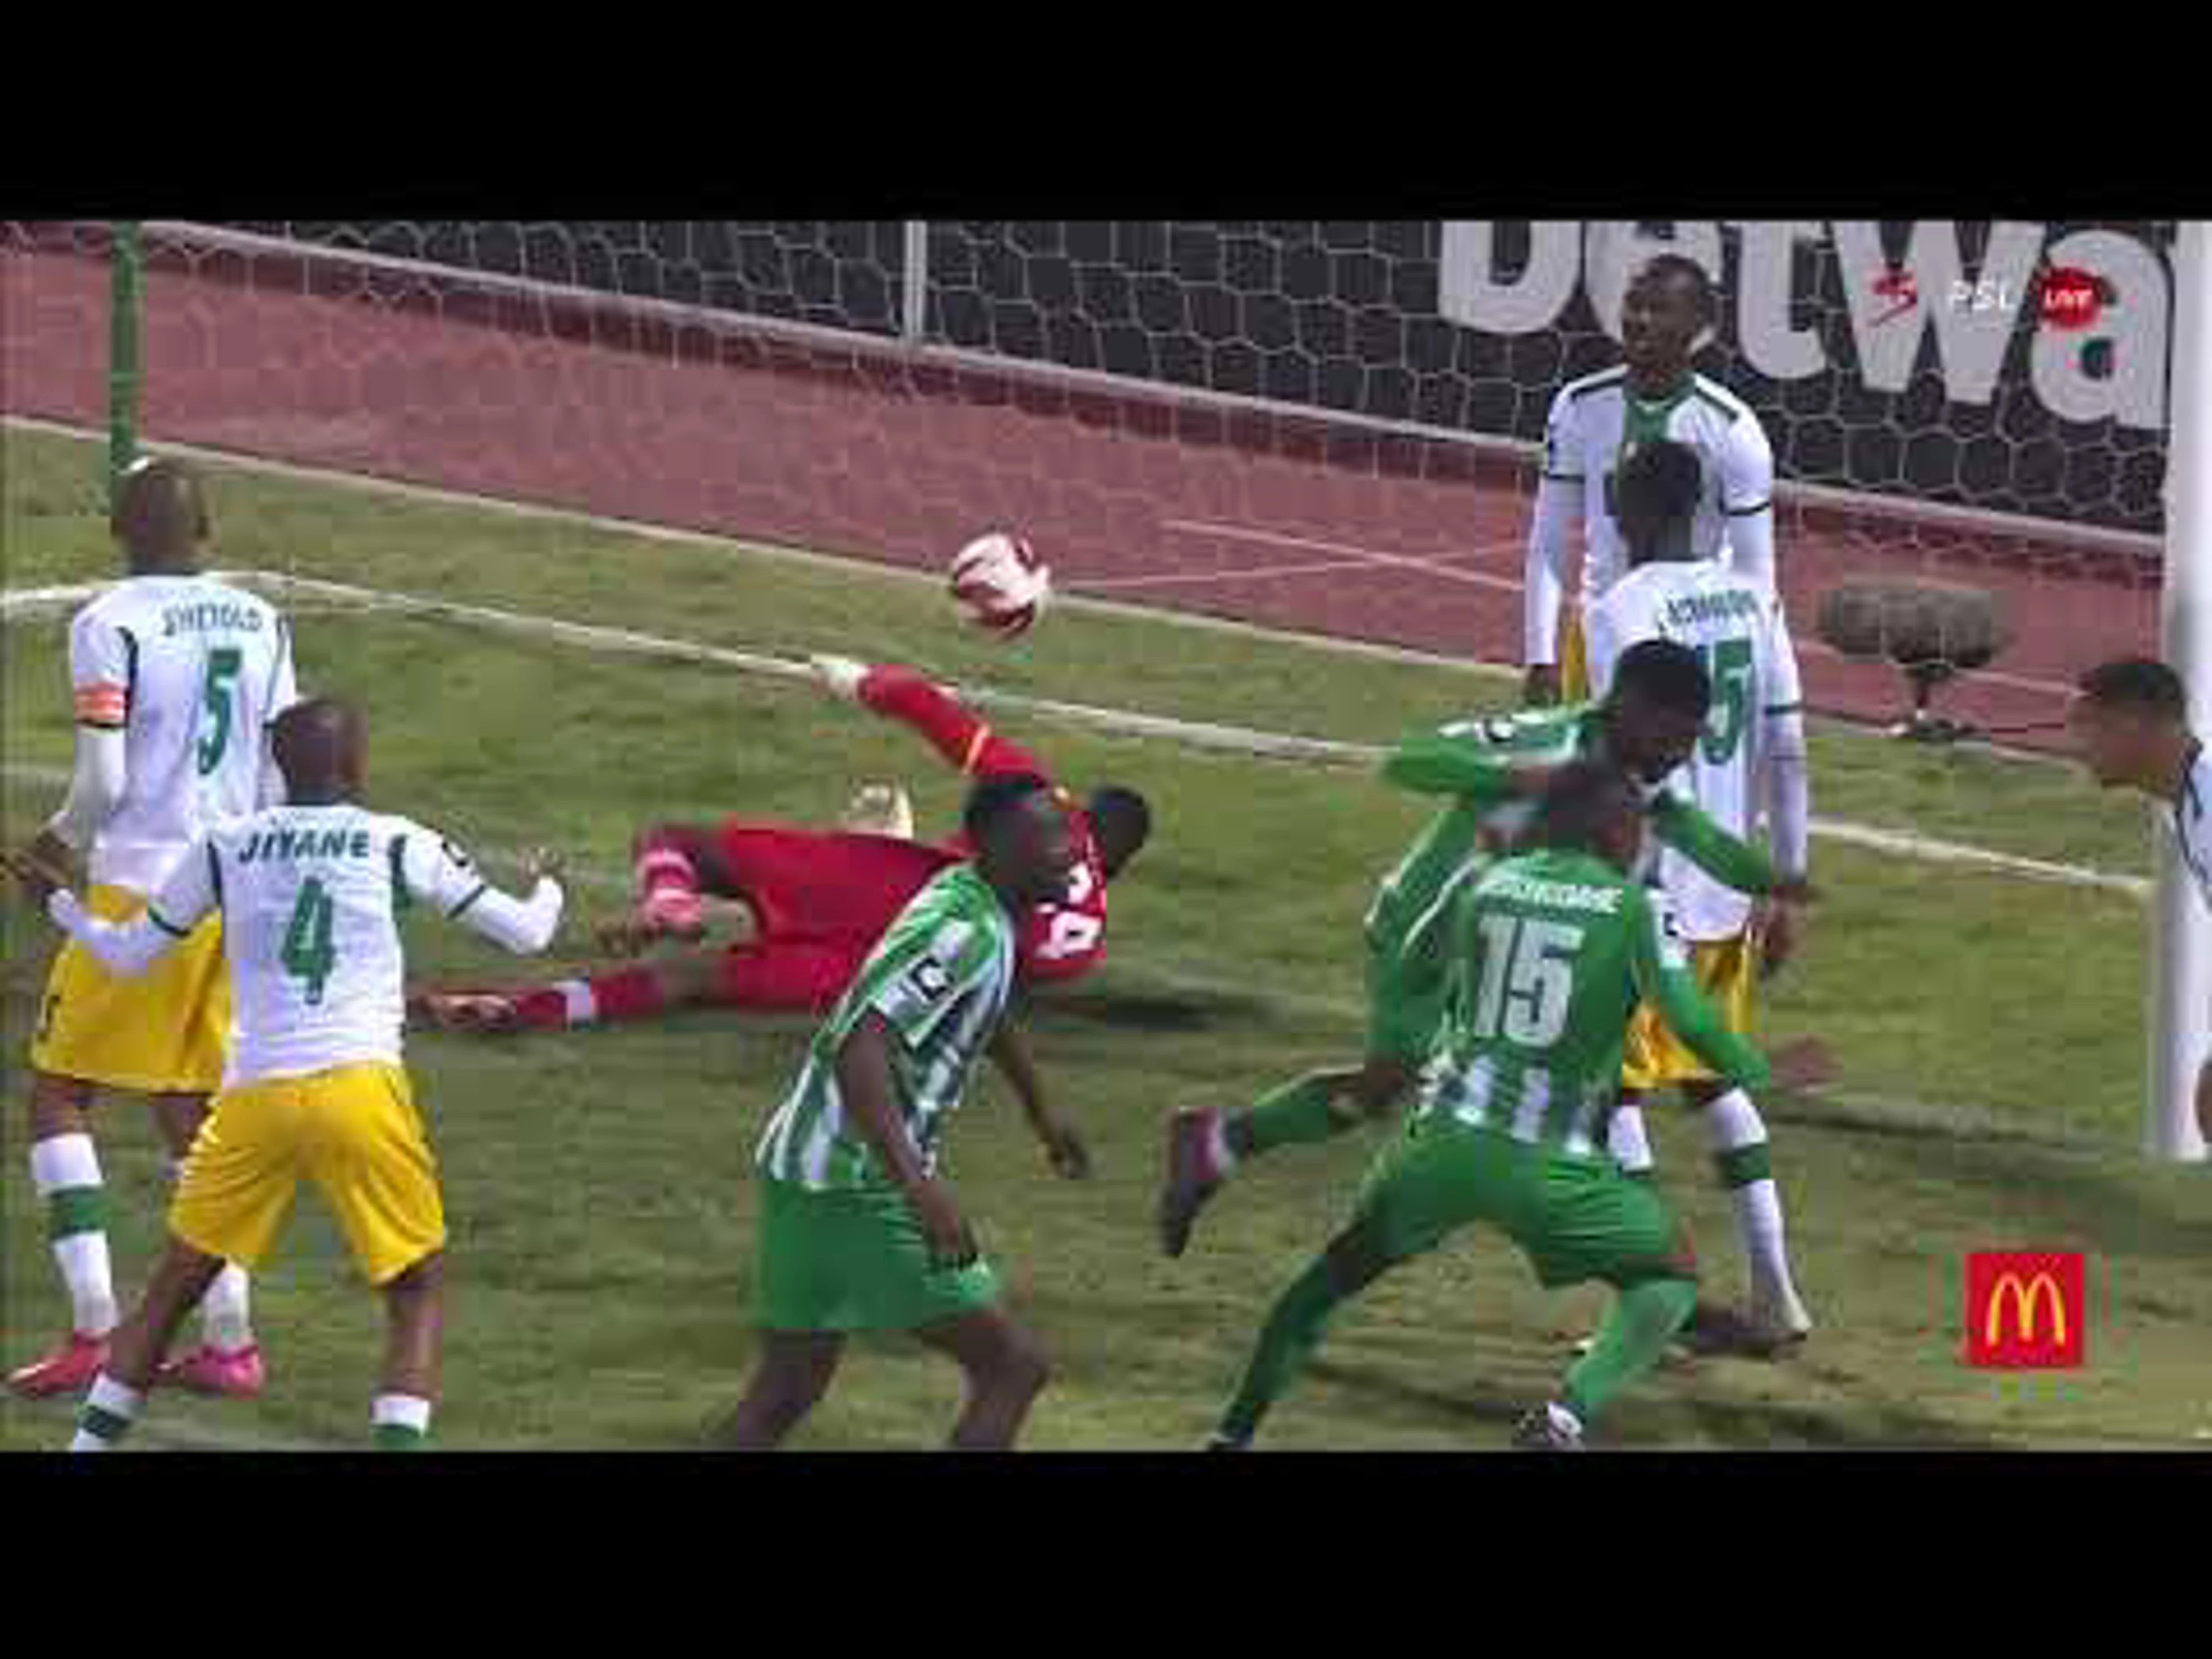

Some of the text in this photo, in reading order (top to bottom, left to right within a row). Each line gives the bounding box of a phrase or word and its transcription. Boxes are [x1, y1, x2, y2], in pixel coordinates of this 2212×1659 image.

[198, 647, 243, 775] 5
[238, 828, 369, 862] JIYANE
[281, 876, 335, 1005] 4
[1475, 913, 1586, 1047] 15
